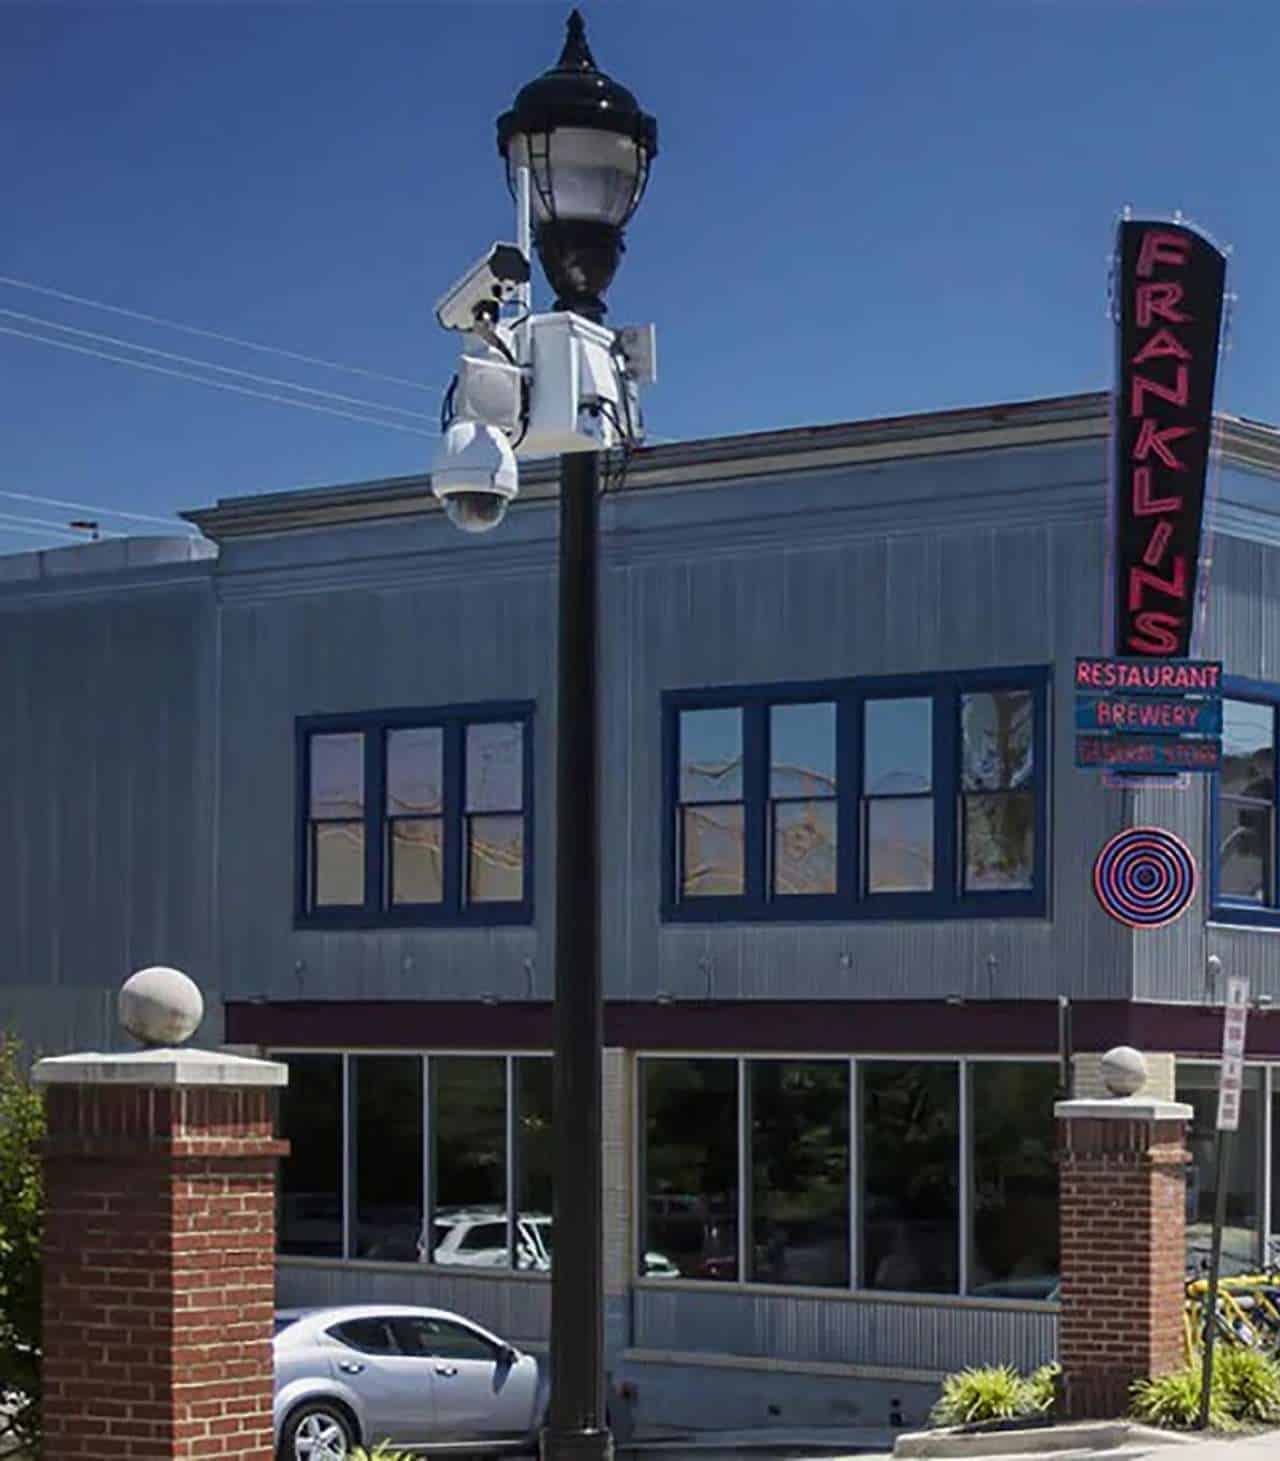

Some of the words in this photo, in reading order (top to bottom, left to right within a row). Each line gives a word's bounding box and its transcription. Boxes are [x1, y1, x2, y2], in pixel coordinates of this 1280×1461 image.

[1129, 231, 1197, 655] FRANKLINS
[1077, 662, 1219, 687] RESTAURANT
[1096, 701, 1199, 727] BREWERY
